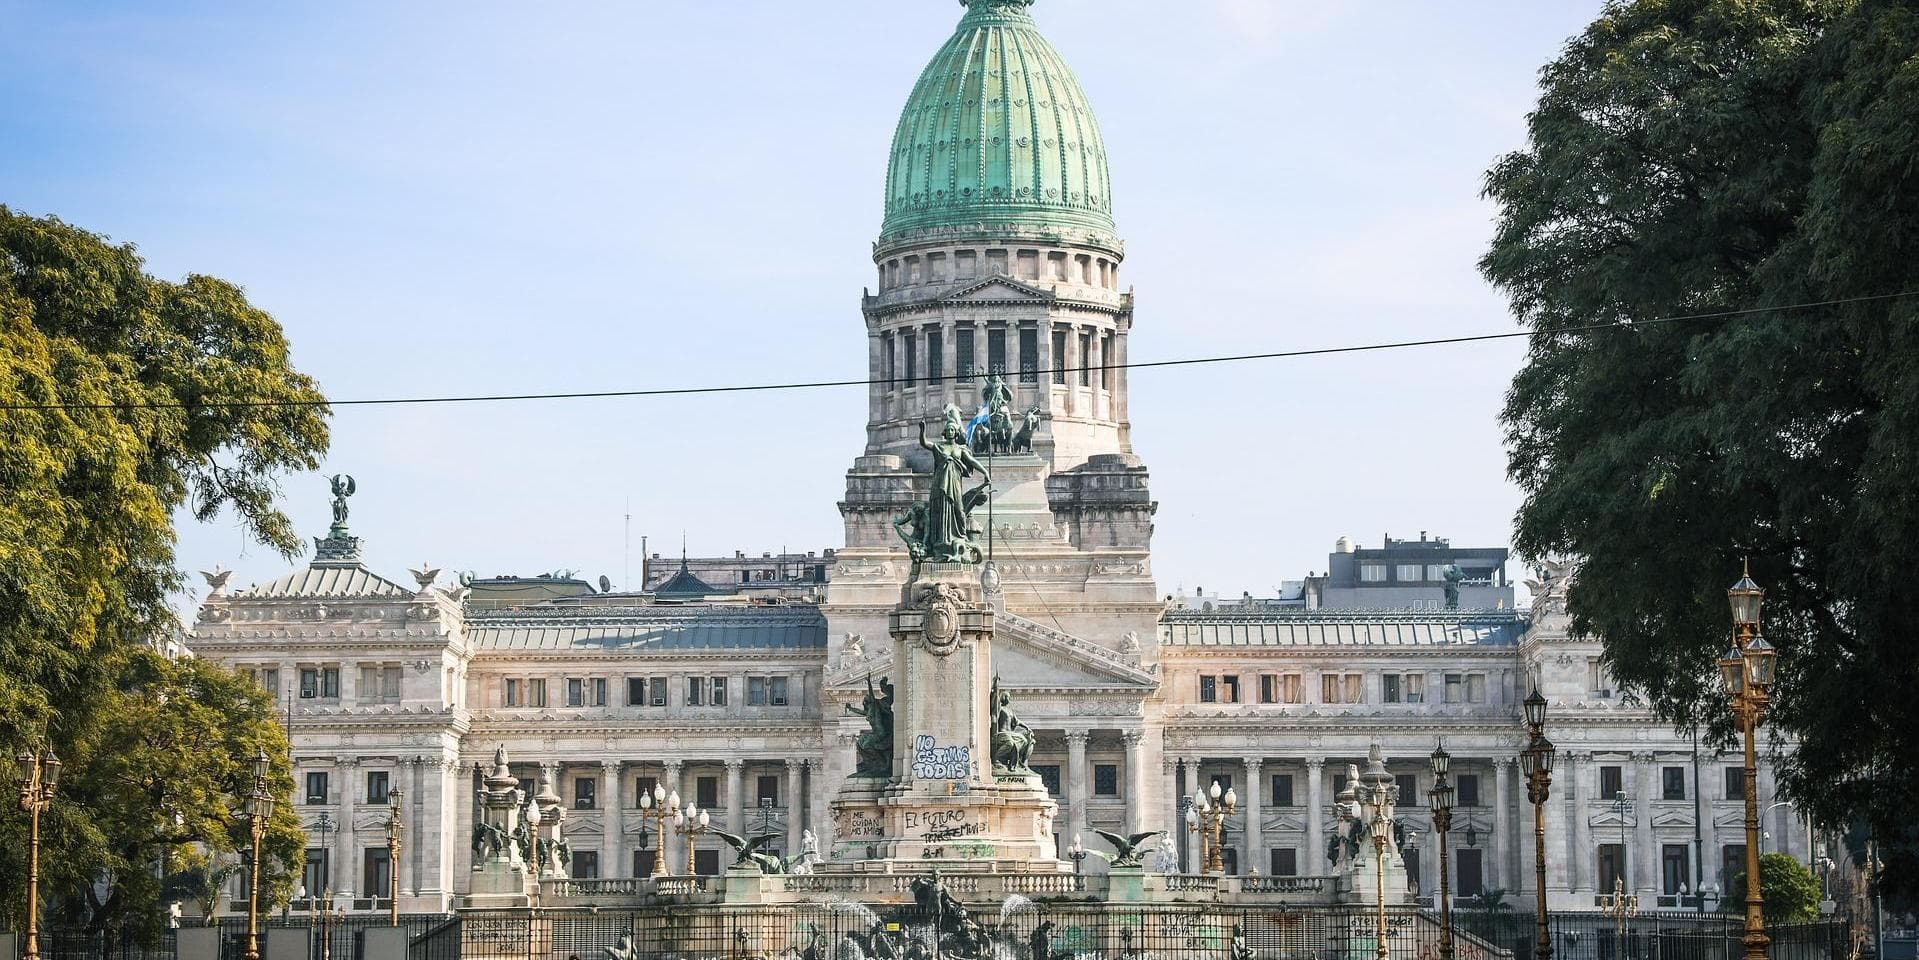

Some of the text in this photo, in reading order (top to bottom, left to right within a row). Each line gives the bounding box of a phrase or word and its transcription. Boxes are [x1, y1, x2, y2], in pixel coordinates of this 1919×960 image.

[916, 734, 935, 751] NO
[912, 762, 966, 779] TODAS
[852, 818, 879, 827] CUIDAN
[853, 811, 865, 819] ME
[922, 809, 965, 826] FUTURO
